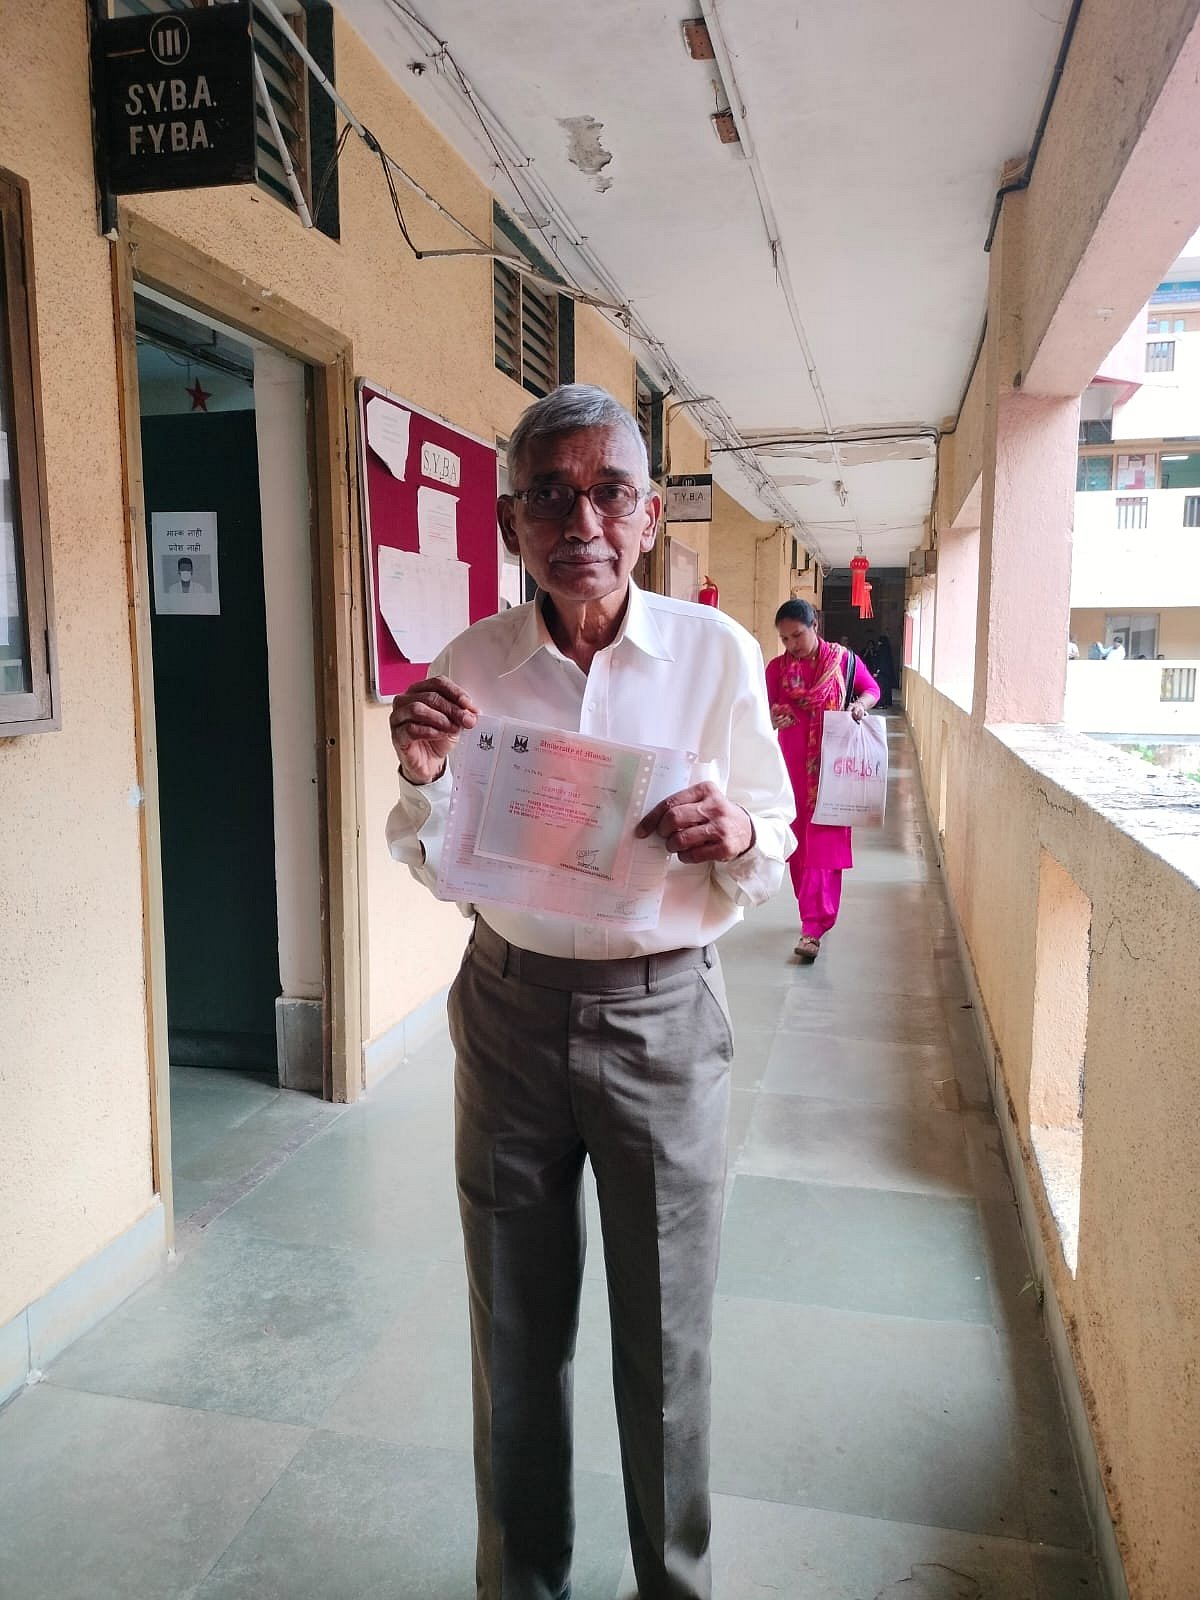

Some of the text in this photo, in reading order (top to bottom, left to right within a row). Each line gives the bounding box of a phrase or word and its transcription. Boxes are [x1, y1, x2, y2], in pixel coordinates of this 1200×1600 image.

[125, 75, 217, 116] S.Y.B.A.
[129, 119, 214, 155] F.Y.B.A.
[187, 528, 202, 538] नाही
[186, 543, 201, 553] नाही
